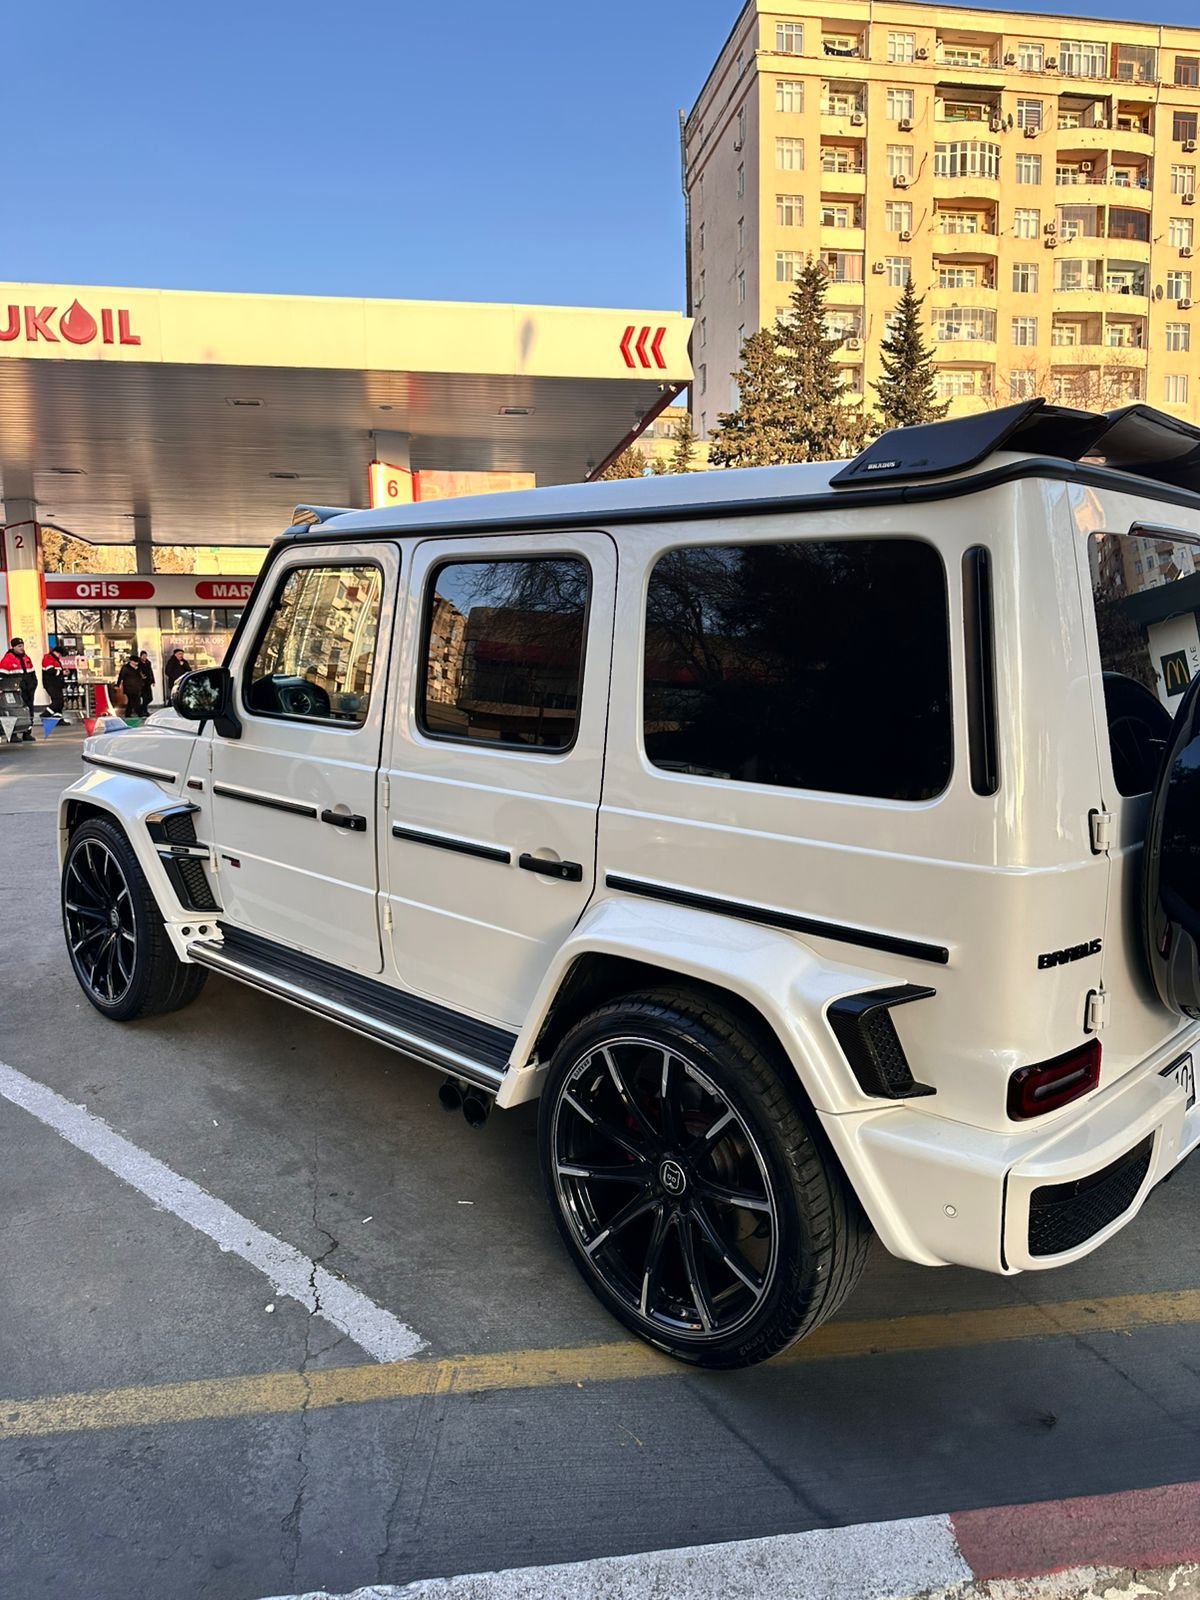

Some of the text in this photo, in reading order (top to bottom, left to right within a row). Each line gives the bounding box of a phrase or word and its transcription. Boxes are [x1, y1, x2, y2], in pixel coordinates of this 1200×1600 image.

[0, 299, 141, 345] UKOIL
[387, 480, 398, 497] 6
[15, 535, 24, 548] 2
[76, 581, 120, 597] OFİS
[212, 584, 252, 597] MAR
[1038, 938, 1102, 969] BRABUS
